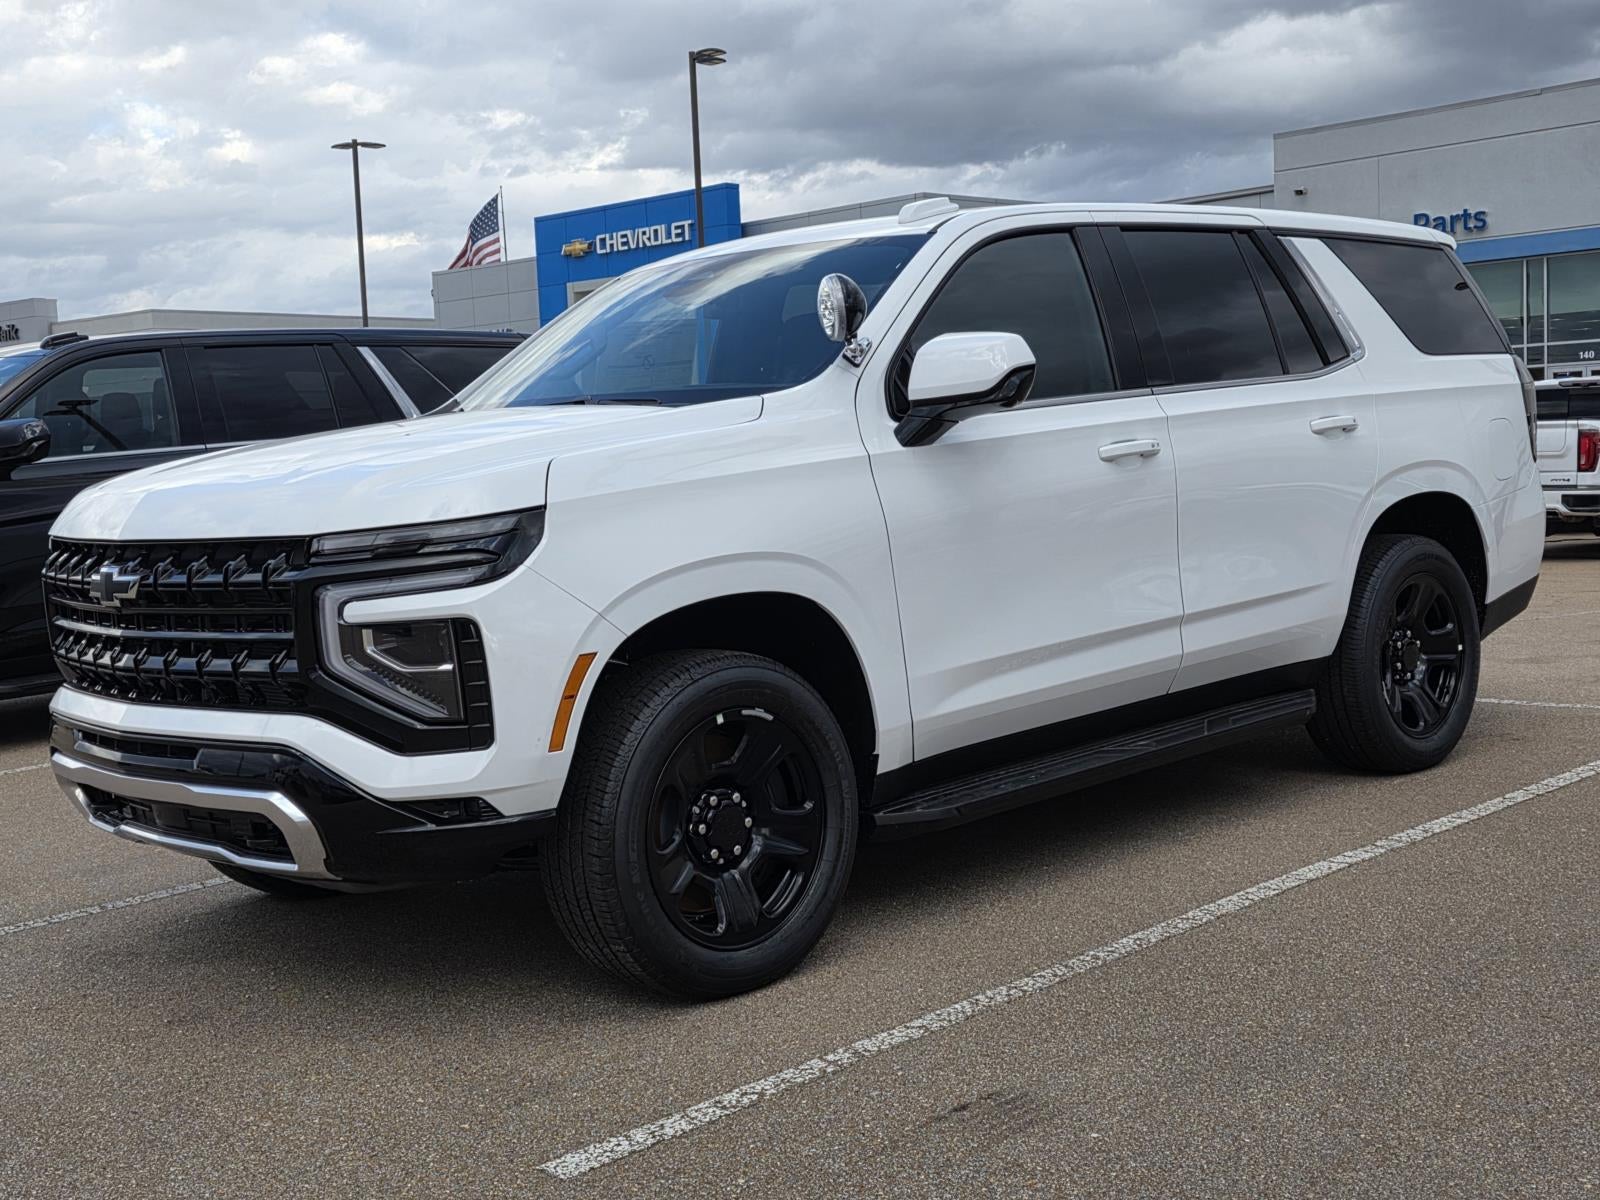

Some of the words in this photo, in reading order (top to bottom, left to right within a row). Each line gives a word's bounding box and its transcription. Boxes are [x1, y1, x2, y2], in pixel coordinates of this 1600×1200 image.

[1413, 208, 1488, 234] Parts
[596, 219, 693, 254] CHEVROLET
[1578, 350, 1595, 359] 140
